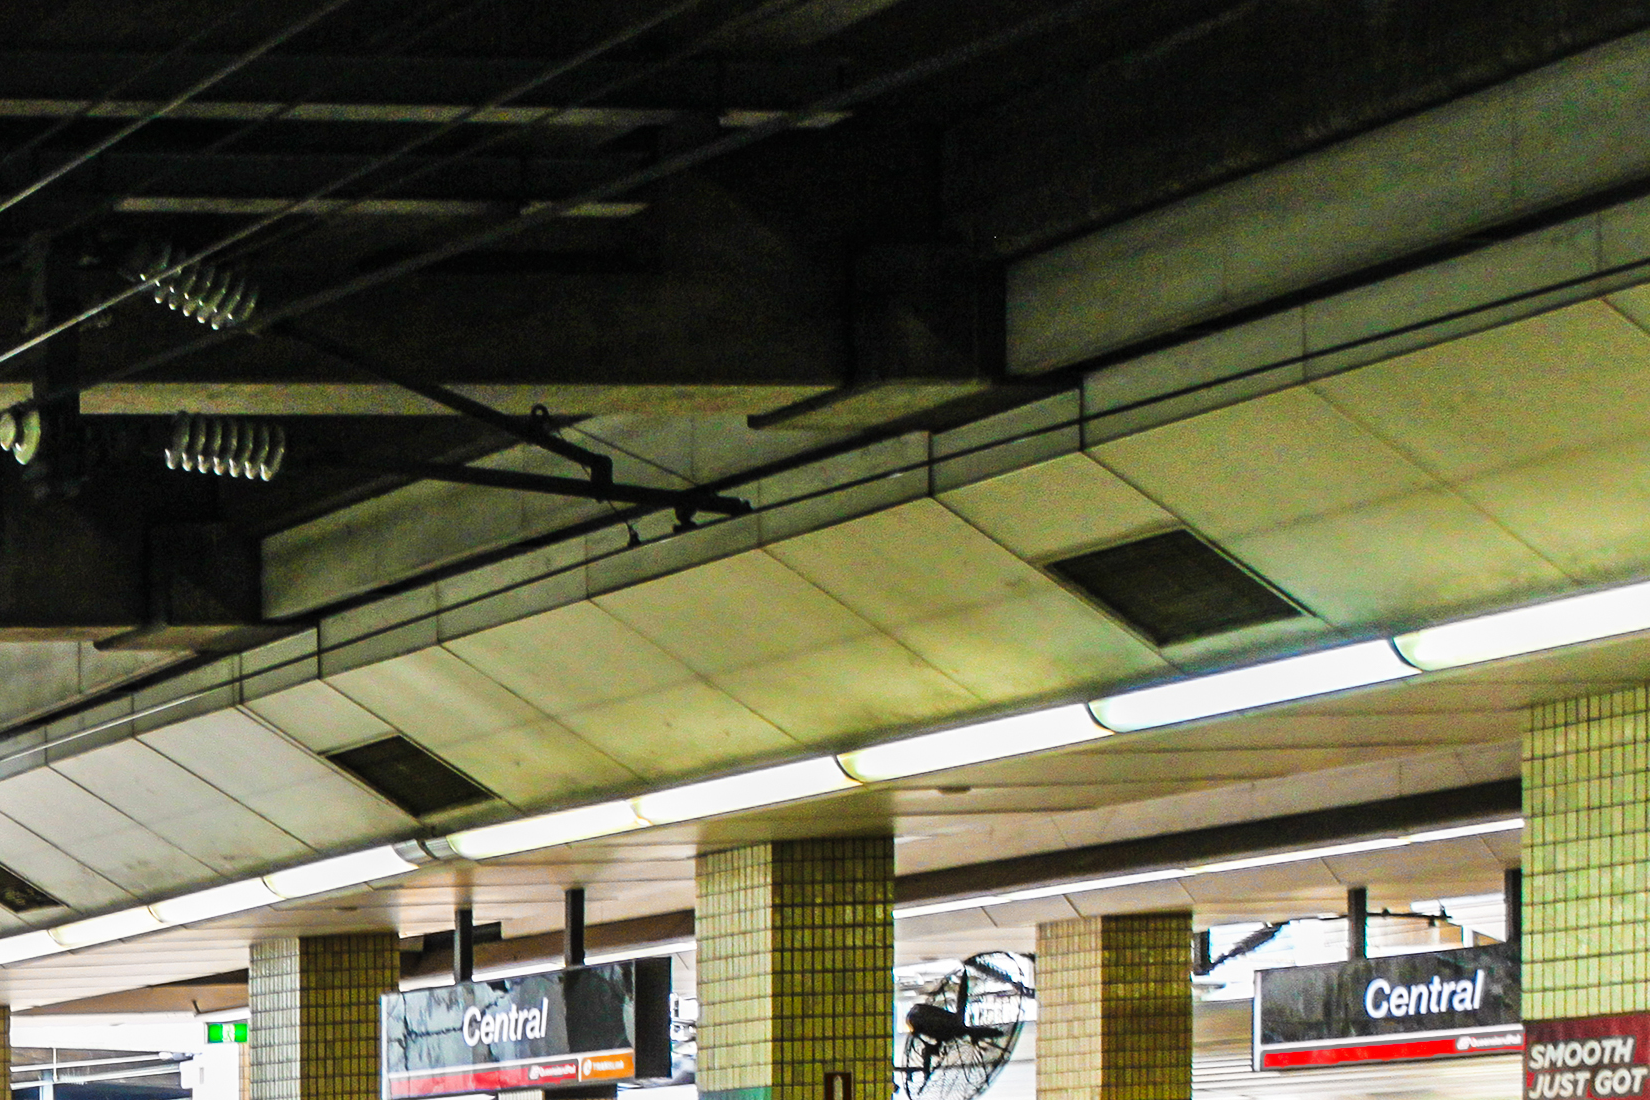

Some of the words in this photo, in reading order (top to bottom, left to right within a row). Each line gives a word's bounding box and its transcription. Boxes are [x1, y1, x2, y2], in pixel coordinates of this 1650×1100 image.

[1365, 969, 1486, 1020] Central
[462, 996, 550, 1047] Central
[1529, 1036, 1635, 1070] SMOOTH
[1528, 1070, 1591, 1099] JUST
[1594, 1067, 1649, 1095] GOT
